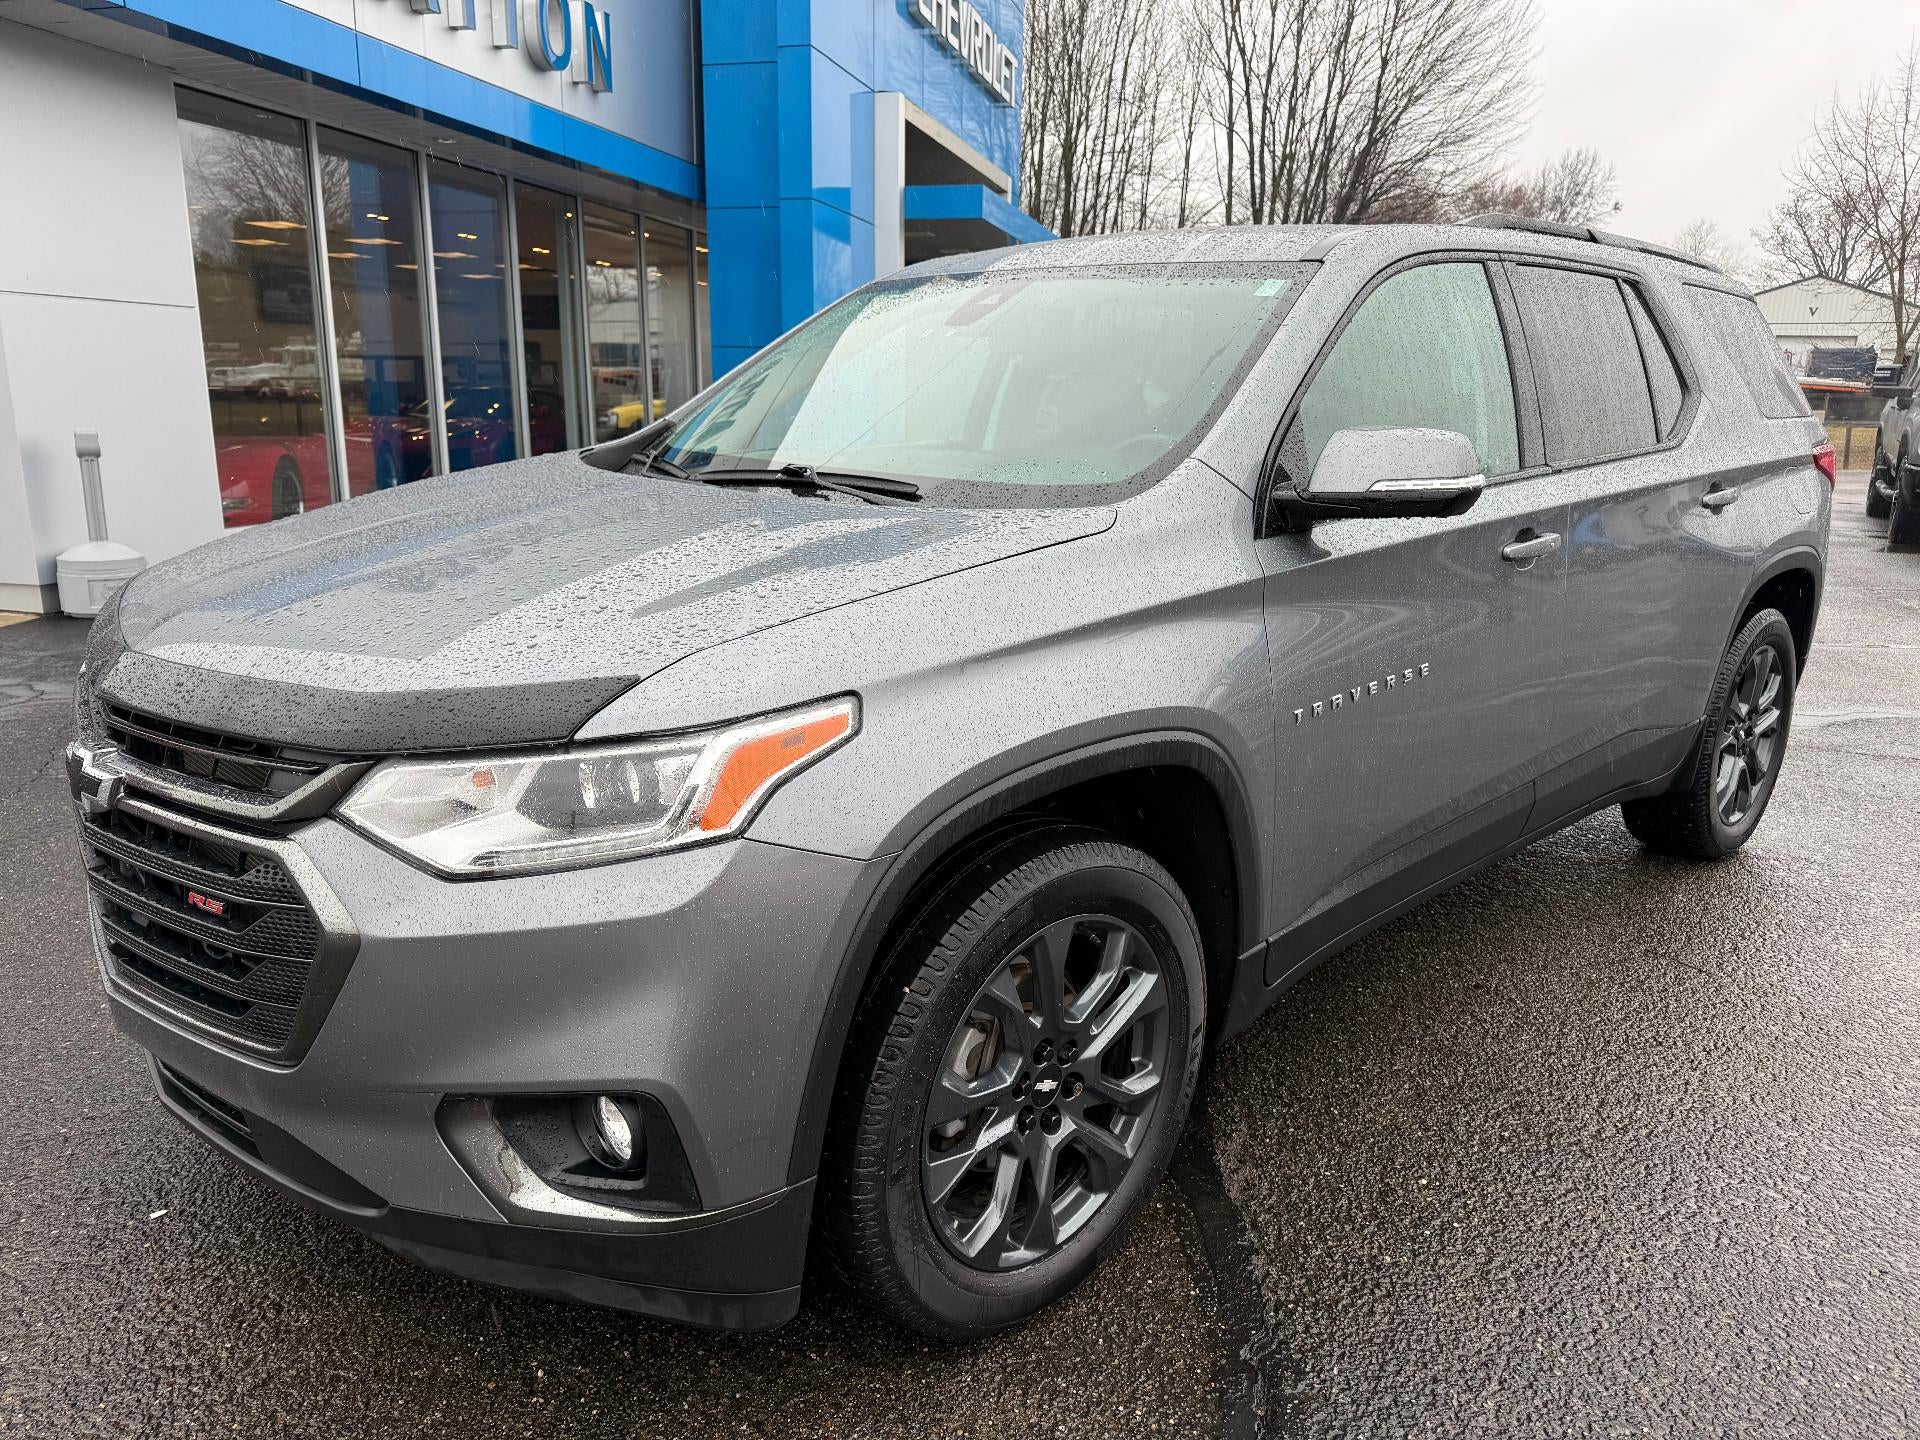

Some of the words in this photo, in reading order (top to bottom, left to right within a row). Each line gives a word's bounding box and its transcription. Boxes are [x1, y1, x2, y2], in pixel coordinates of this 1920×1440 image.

[918, 0, 1019, 108] HEVROLET
[1293, 663, 1430, 725] TRAVERSE
[187, 891, 225, 915] RS
